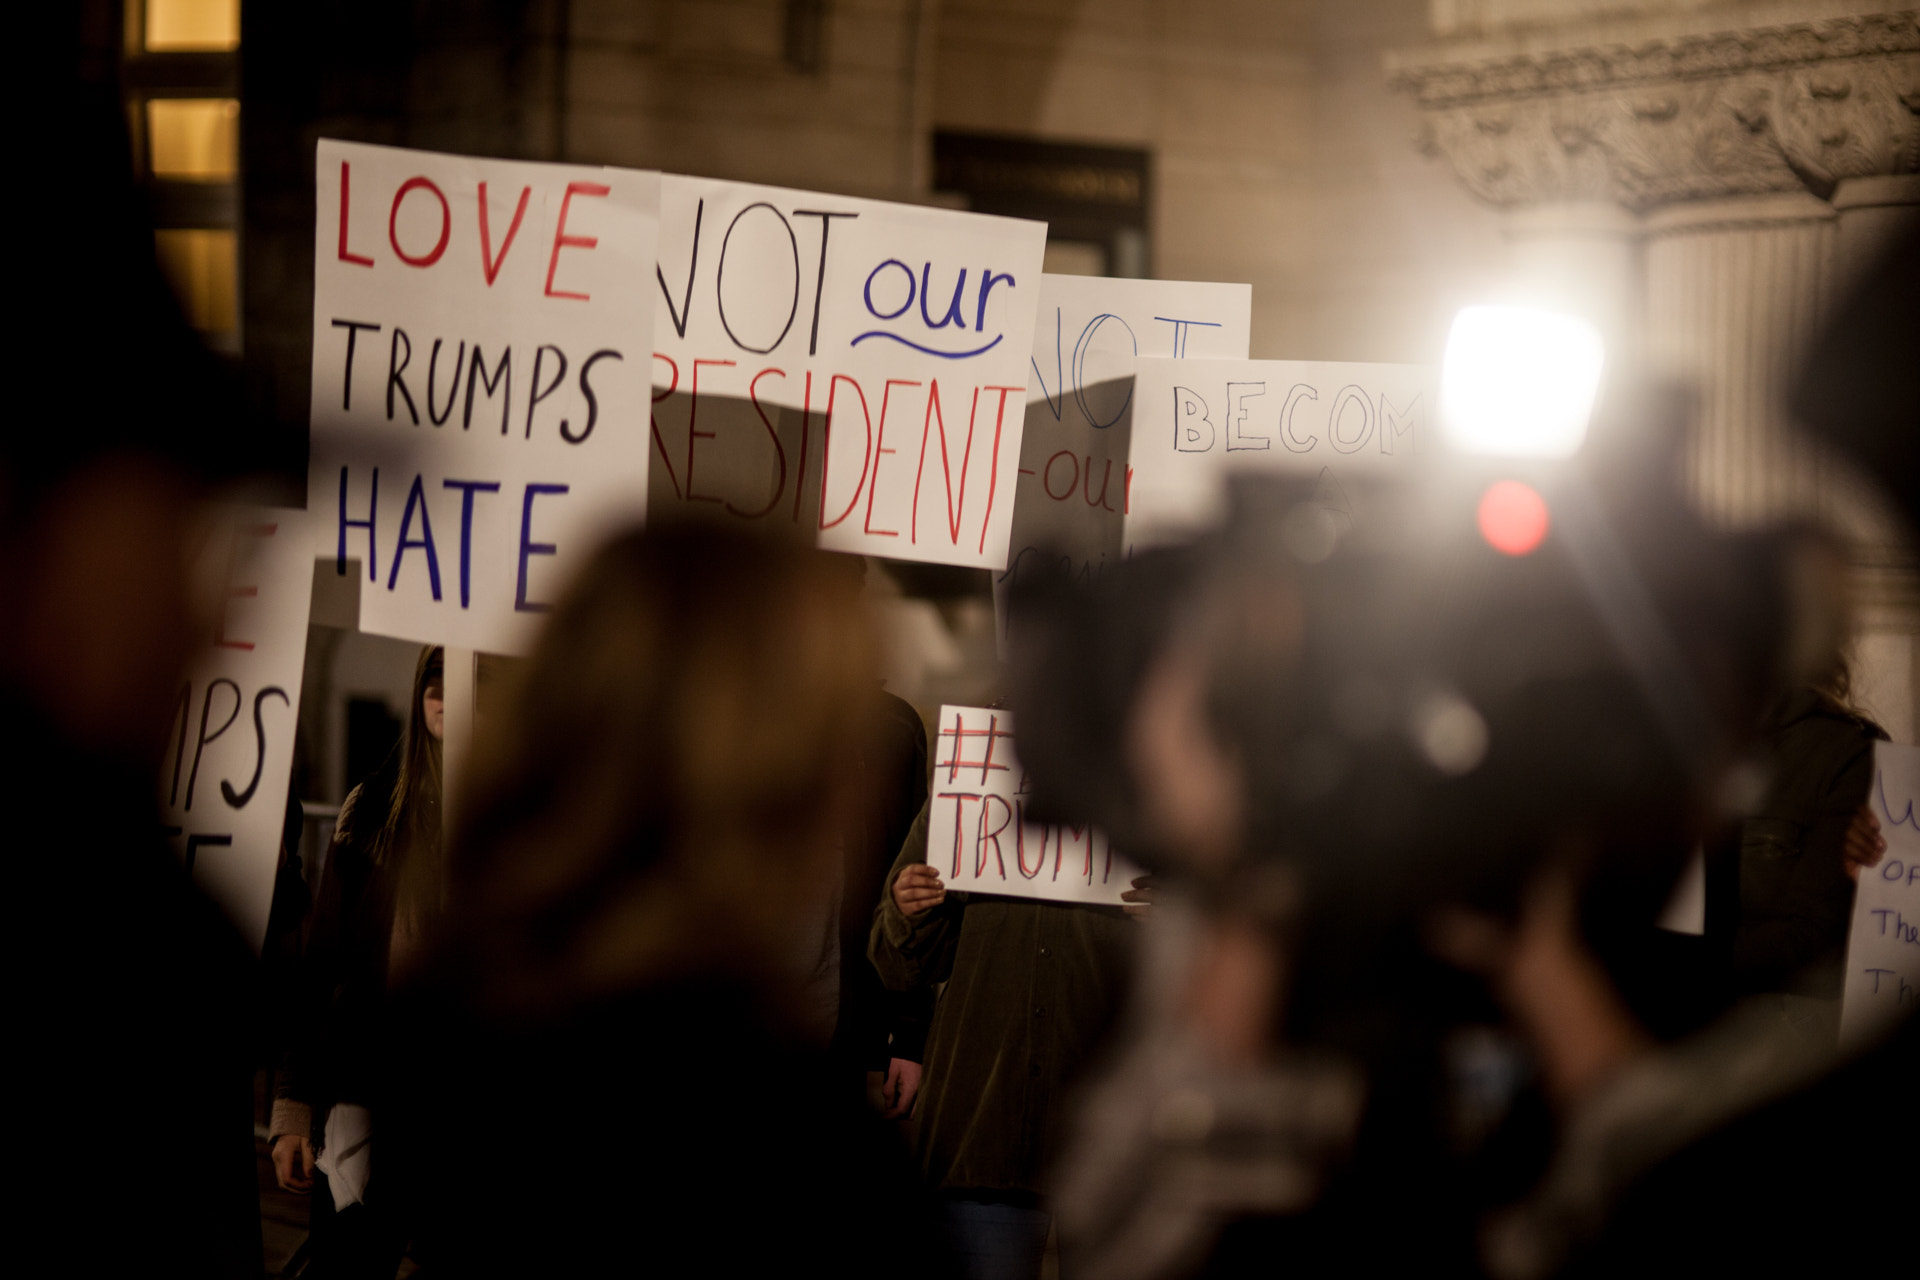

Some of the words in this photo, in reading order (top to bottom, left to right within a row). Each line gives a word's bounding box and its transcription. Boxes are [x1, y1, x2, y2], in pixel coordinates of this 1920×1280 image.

[337, 159, 611, 301] LOVE
[863, 257, 1016, 333] our
[330, 318, 625, 446] TRUMPS
[336, 465, 571, 614] HATE
